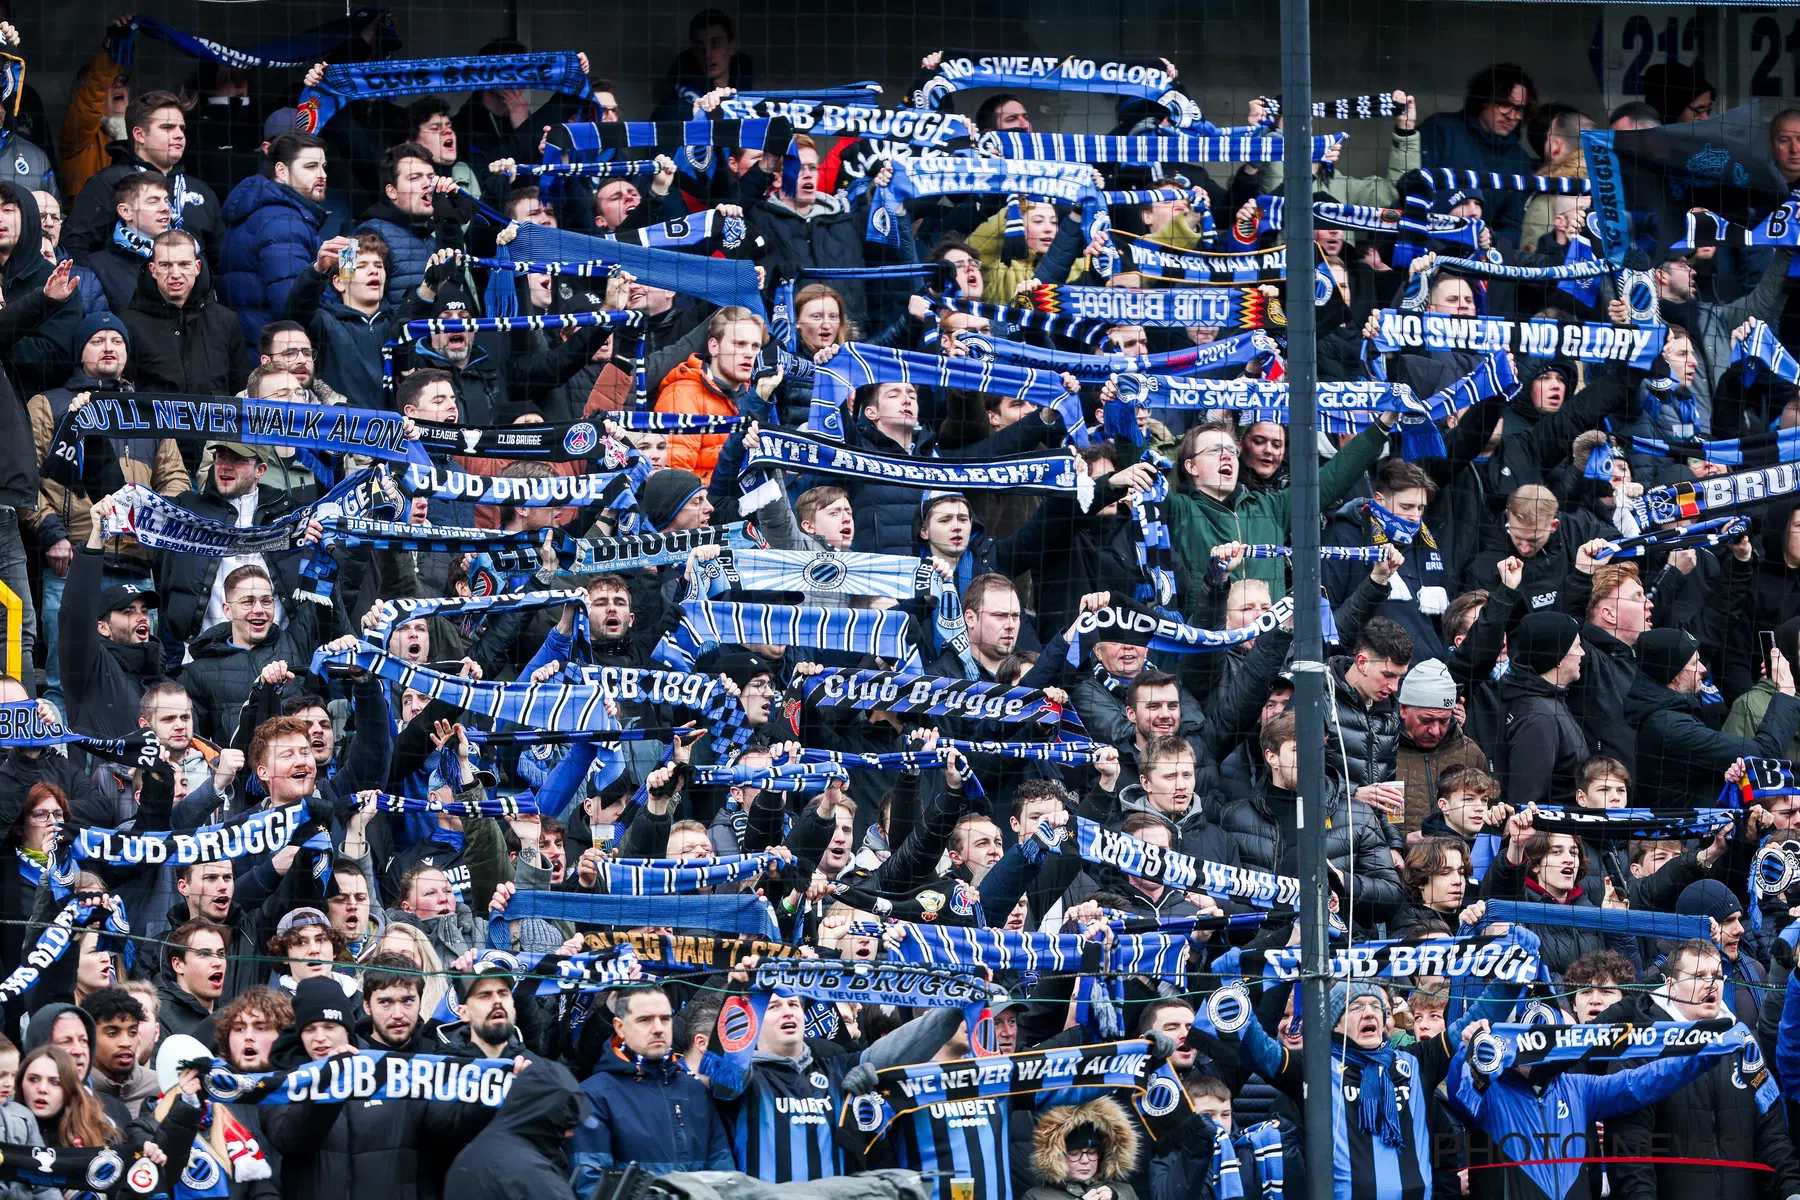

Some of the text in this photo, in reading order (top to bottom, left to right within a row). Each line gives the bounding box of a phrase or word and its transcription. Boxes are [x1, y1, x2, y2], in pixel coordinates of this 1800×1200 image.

[940, 56, 1173, 92] NO SWEAT NO GLORY
[823, 104, 964, 146] BRUGGE
[911, 173, 1081, 202] WALK ALONE
[1006, 160, 1094, 186] NEVER
[1129, 244, 1157, 265] WE
[1158, 248, 1207, 272] NEVER
[1208, 254, 1260, 273] WALK
[446, 301, 467, 310] 1891
[1070, 292, 1229, 321] CLUB BRUGGE
[1382, 314, 1652, 363] NO SWEAT NO GLORY
[1170, 389, 1199, 406] NO
[1318, 391, 1384, 408] GLORY
[73, 399, 150, 431] OU'LL
[153, 400, 238, 433] NEVER
[246, 404, 323, 440] WALK
[431, 429, 459, 442] LEAGUE
[498, 434, 515, 445] CLUB
[515, 434, 542, 446] BRUGGE
[748, 433, 1050, 484] ANTI ANDERLECHT
[1702, 462, 1800, 510] BRU
[160, 520, 235, 548] MADRID
[718, 555, 740, 583] CLUB
[916, 562, 934, 591] CLUB
[1076, 605, 1199, 646] GOUDEN
[581, 666, 718, 710] FCB 1891
[824, 674, 1023, 718] Club Brugge
[80, 827, 168, 865] CLUB
[172, 806, 303, 864] BRUGGE
[1090, 825, 1161, 877] GLORY
[1165, 852, 1197, 887] NO
[1202, 860, 1276, 901] SWEAT
[671, 935, 715, 966] VAN
[1389, 944, 1541, 984] BRUGGE
[756, 961, 845, 991] CLUB
[828, 990, 871, 1002] NEVER
[879, 994, 918, 1006] WALK
[322, 1008, 343, 1021] 1891
[1516, 1026, 1727, 1053] NO HEART NO GLORY
[287, 1055, 377, 1101] CLUB
[897, 1053, 1152, 1099] WE NEVER WALK ALONE
[776, 1096, 834, 1114] UNIBET
[931, 1099, 997, 1119] UNIBET
